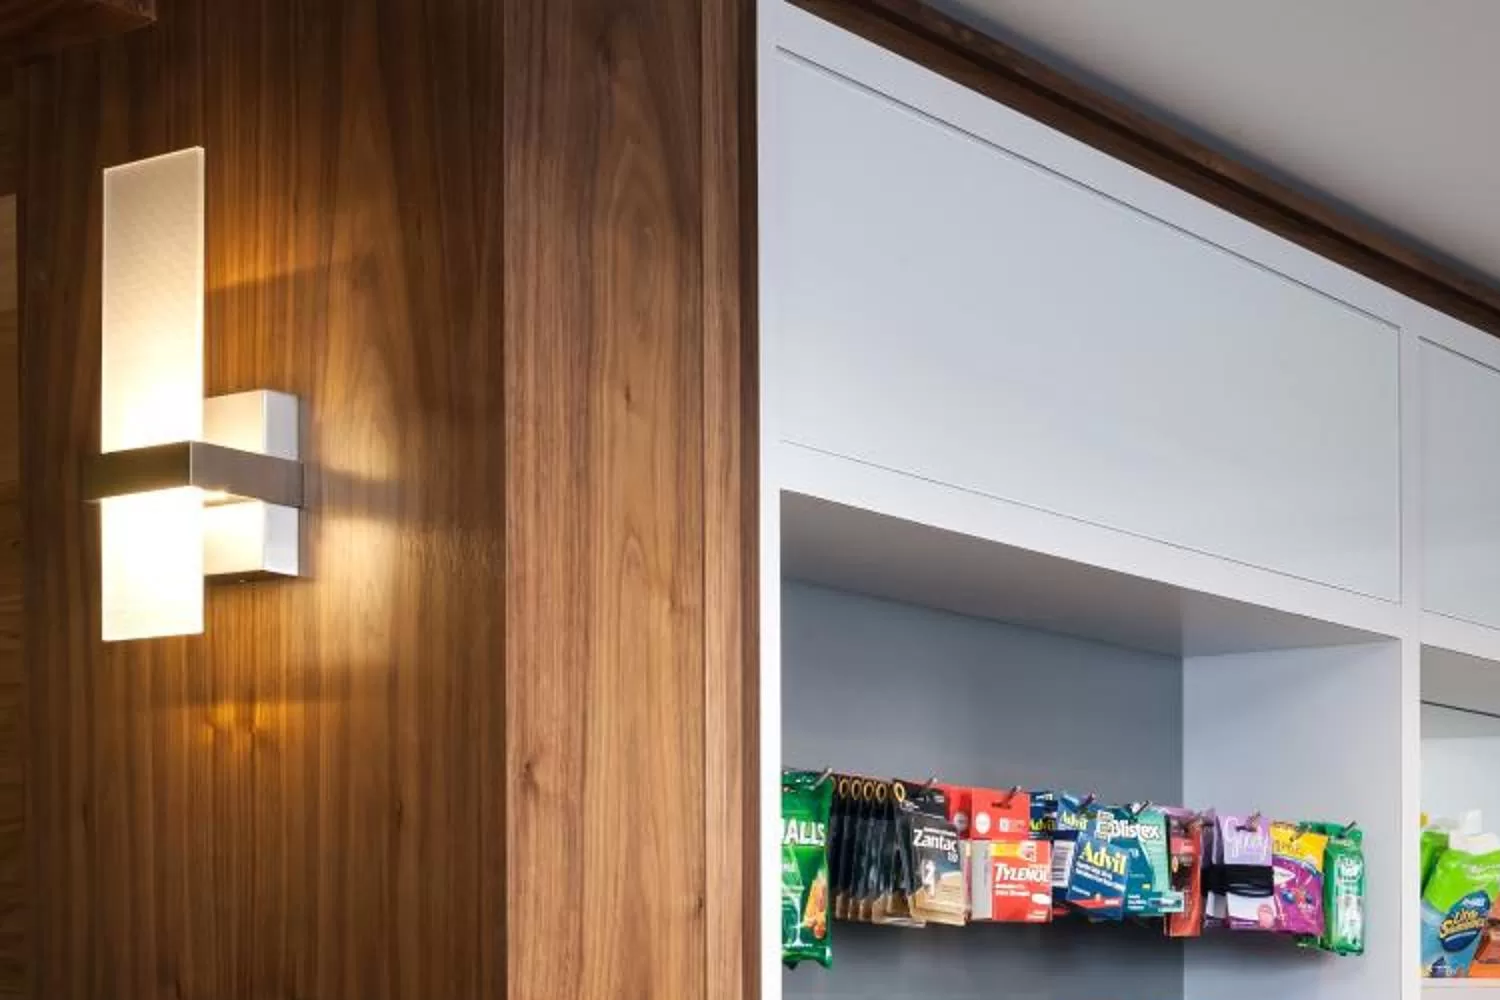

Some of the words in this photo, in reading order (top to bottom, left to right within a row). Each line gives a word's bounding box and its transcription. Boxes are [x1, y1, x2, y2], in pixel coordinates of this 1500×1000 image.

[913, 829, 958, 852] Zantac
[1080, 841, 1128, 876] Advil
[994, 863, 1050, 882] TYLENOL
